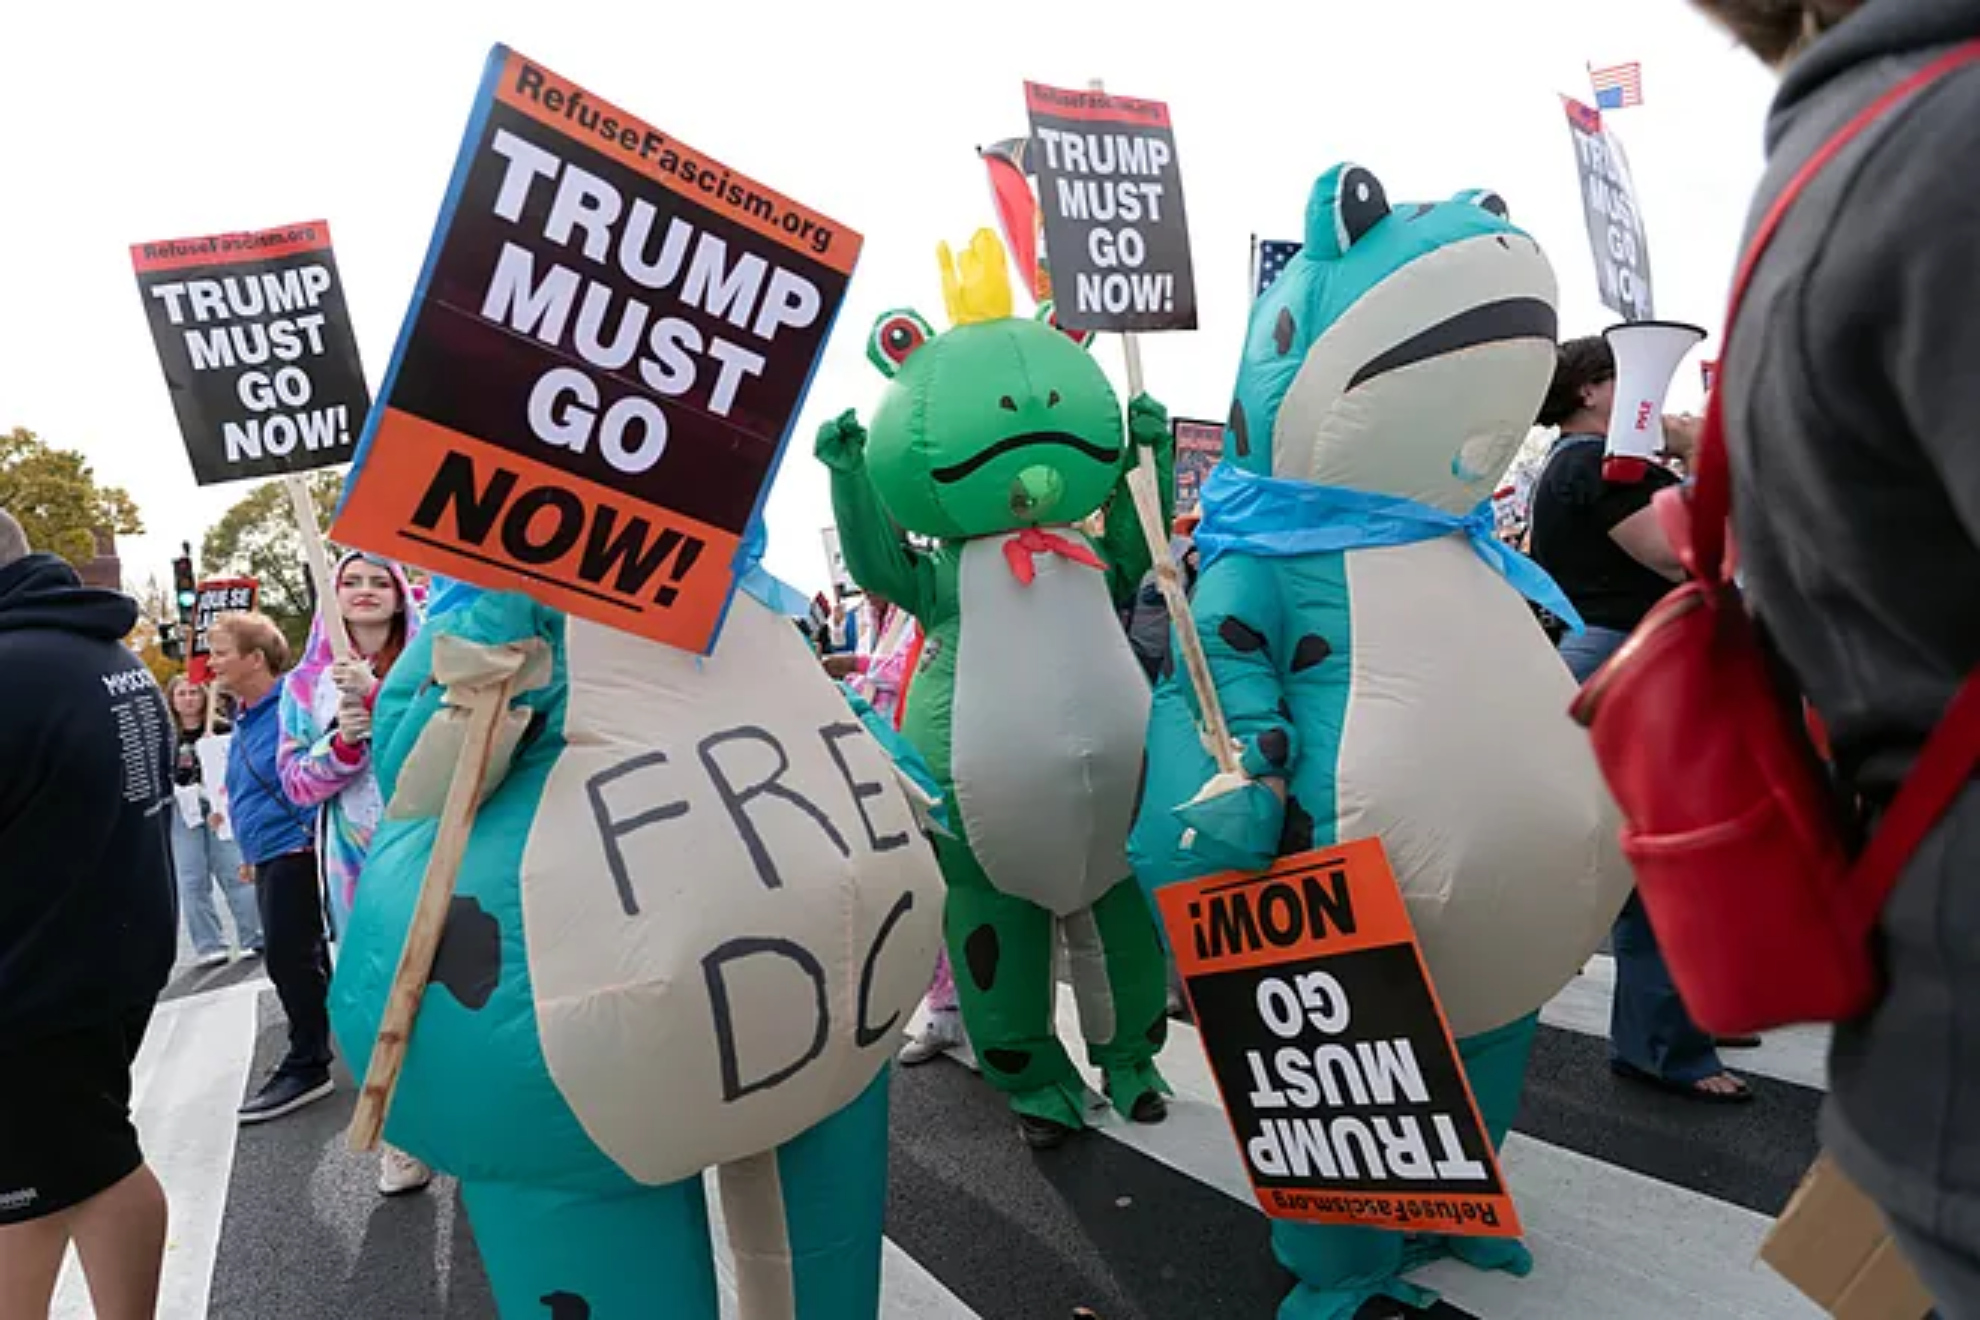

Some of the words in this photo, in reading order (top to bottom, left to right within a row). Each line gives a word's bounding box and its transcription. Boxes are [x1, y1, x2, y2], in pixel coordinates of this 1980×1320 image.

[515, 60, 833, 254] RefuseFascism.org
[1037, 127, 1169, 176] TRUMP
[1056, 178, 1163, 222] MUST
[143, 227, 316, 260] RefuseFascism.org
[490, 127, 822, 342] TRUMP
[1089, 227, 1144, 268] GO
[152, 265, 331, 325] TRUMP
[1076, 273, 1174, 314] NOW!
[182, 315, 326, 371] MUST
[480, 242, 765, 417] MUST
[237, 366, 313, 413] GO
[526, 367, 669, 474] GO
[223, 405, 350, 462] NOW!
[411, 450, 707, 607] NOW!
[1188, 869, 1357, 960] NOW!
[701, 890, 914, 1104] DC
[1255, 970, 1352, 1039] GO
[1245, 1037, 1430, 1109] MUST
[1247, 1114, 1488, 1181] TRUMP
[1271, 1190, 1500, 1228] RefuseFascism.org
